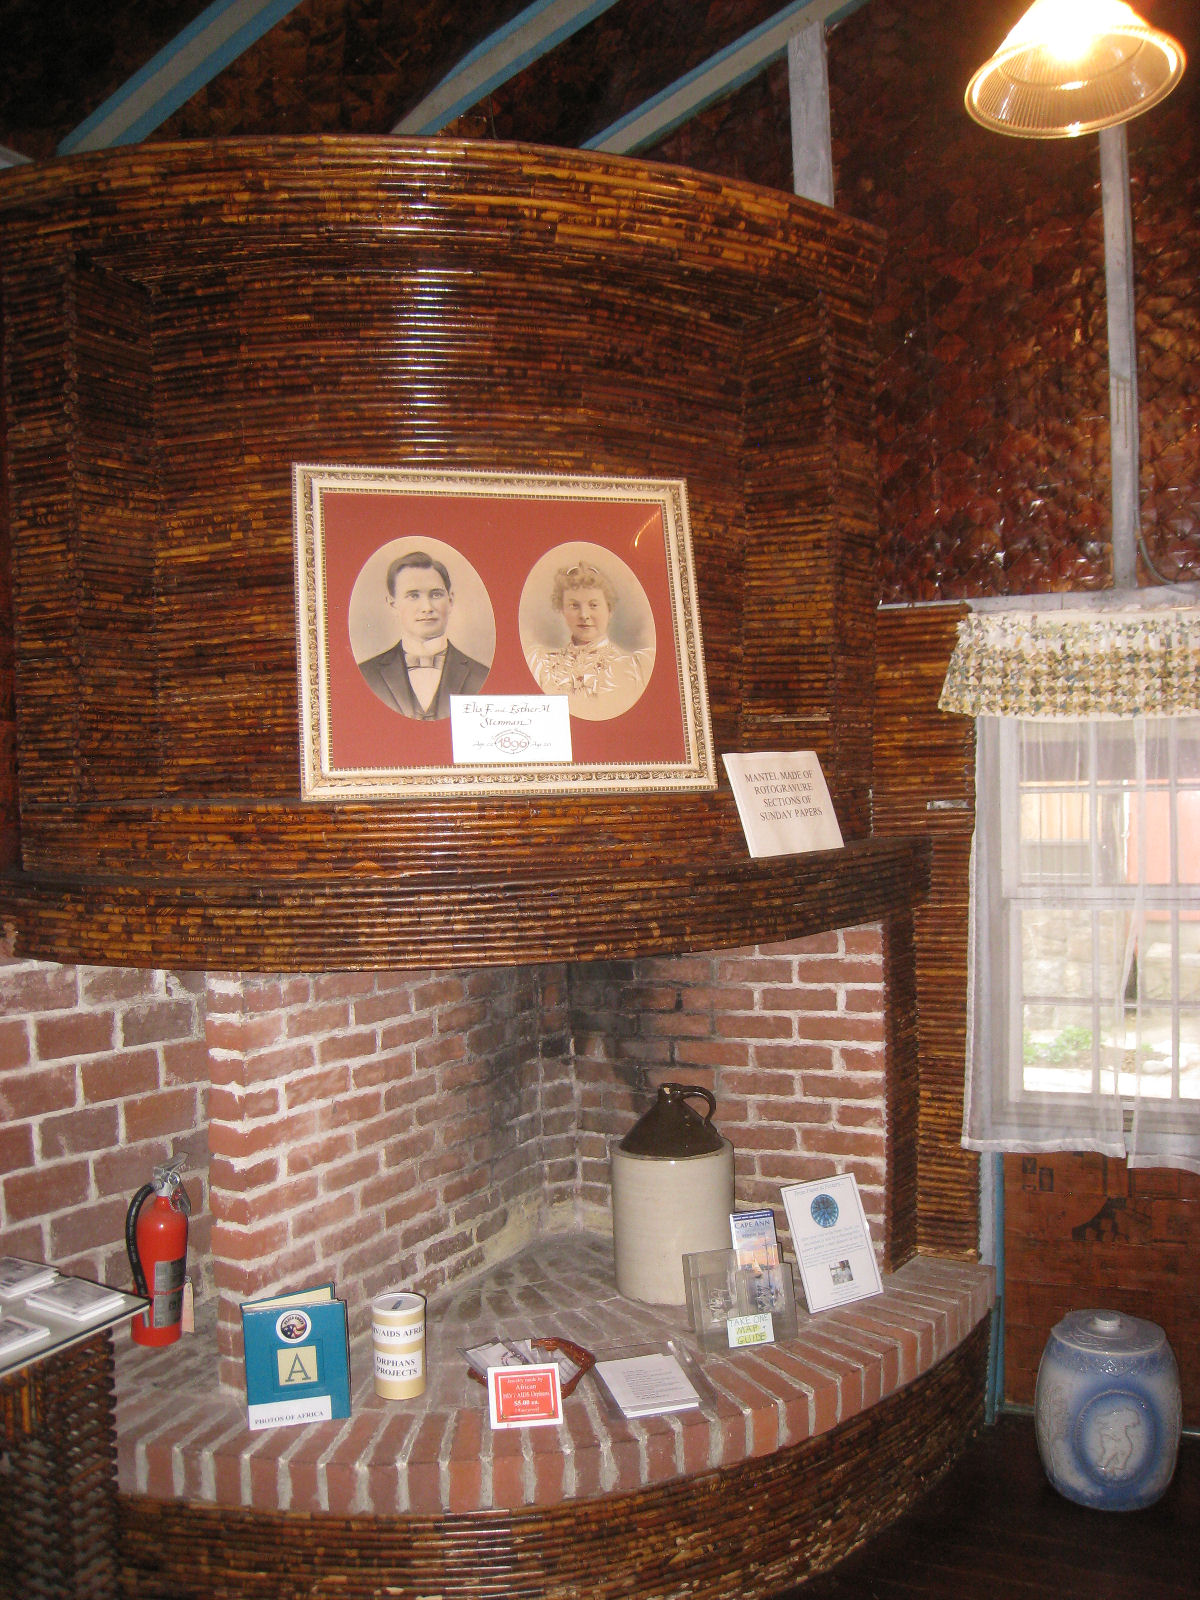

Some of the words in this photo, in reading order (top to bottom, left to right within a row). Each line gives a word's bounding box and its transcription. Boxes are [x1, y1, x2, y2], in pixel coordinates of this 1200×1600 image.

[509, 702, 538, 715] Esther
[498, 736, 528, 751] 1896
[744, 772, 778, 782] MANTEL
[780, 770, 801, 780] MADE
[803, 770, 813, 779] OF
[754, 783, 813, 795] ROTOGRAVURE
[764, 796, 800, 808] SECTIONS
[802, 796, 812, 804] OF
[759, 810, 793, 822] SUNDAY
[795, 808, 822, 818] PAPERS
[755, 1219, 770, 1227] ANN
[730, 1316, 750, 1327] TAKE
[753, 1313, 769, 1324] ONE
[372, 1327, 400, 1338] IV/AIDS
[737, 1324, 758, 1334] MAP
[738, 1333, 767, 1344] GUIDE
[285, 1353, 312, 1382] A
[376, 1356, 416, 1367] ORPHANS
[376, 1365, 418, 1377] PROJECTS
[255, 1414, 284, 1425] PHOTOS
[298, 1411, 325, 1420] AFRICA
